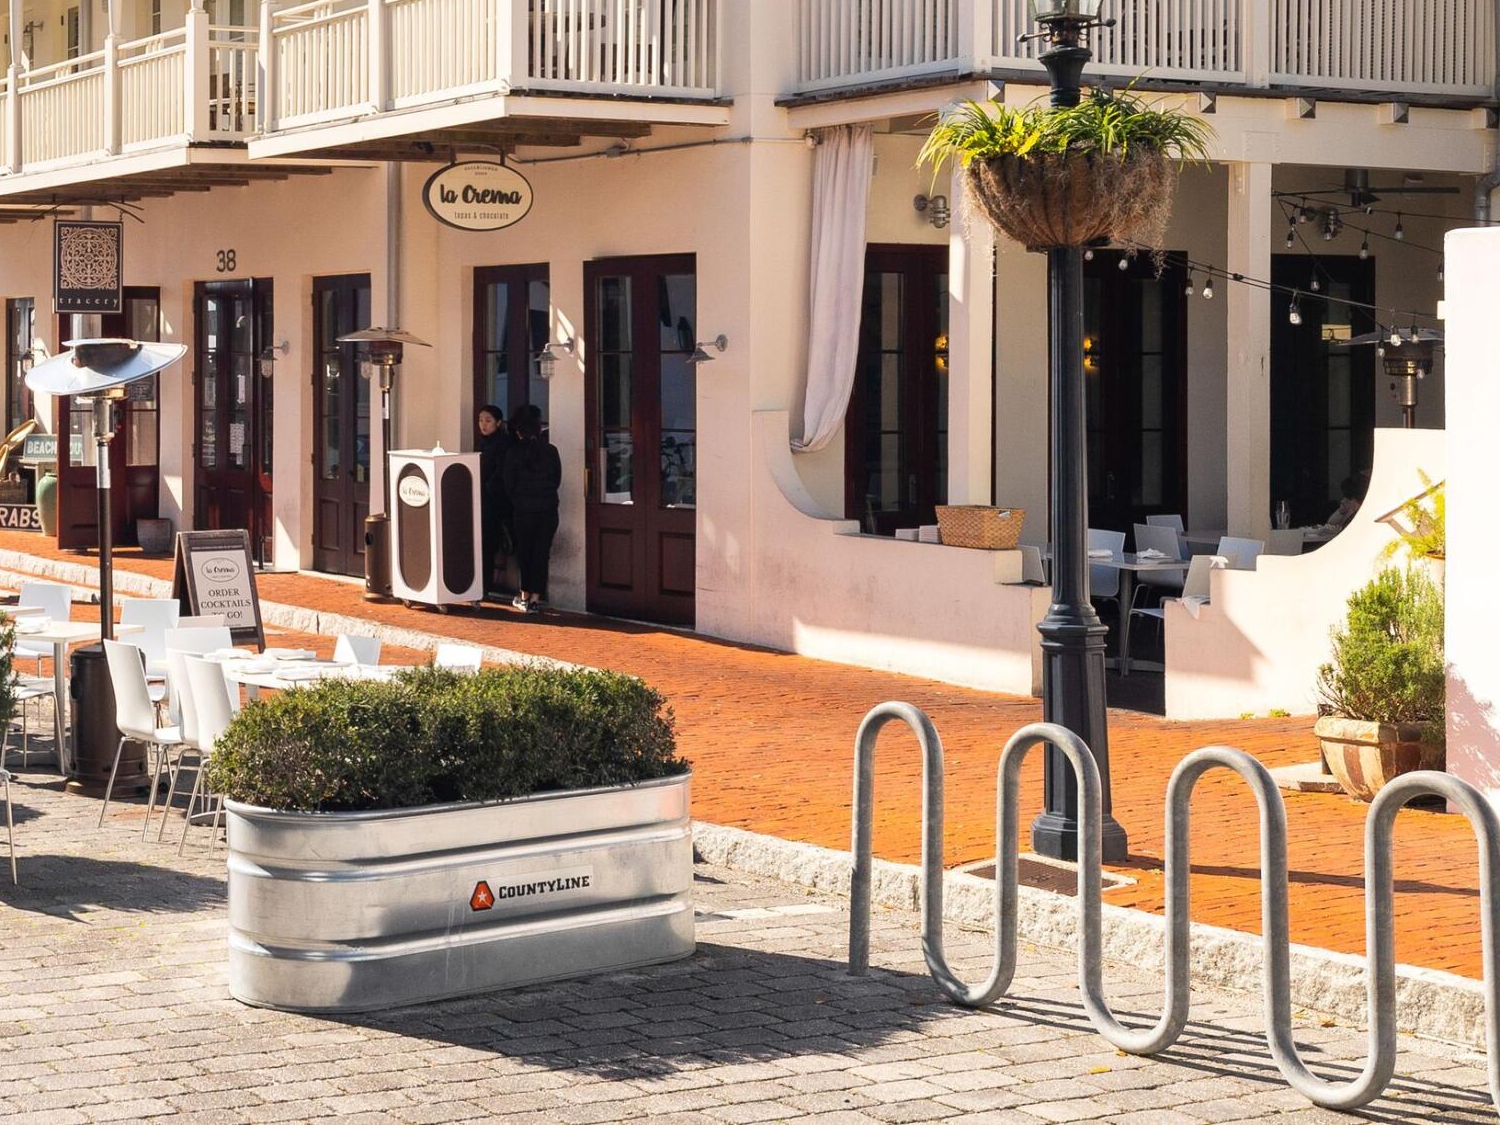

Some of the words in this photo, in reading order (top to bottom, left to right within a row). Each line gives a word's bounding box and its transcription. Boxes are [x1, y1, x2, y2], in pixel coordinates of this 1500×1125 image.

[440, 184, 458, 204] la
[462, 184, 522, 205] Crema
[454, 211, 471, 220] tapas
[479, 211, 509, 220] chocolate
[216, 249, 237, 273] 38
[59, 296, 119, 307] tracery
[208, 588, 240, 597] ORDER
[201, 599, 251, 609] COCKTAILS
[227, 610, 243, 619] GO!
